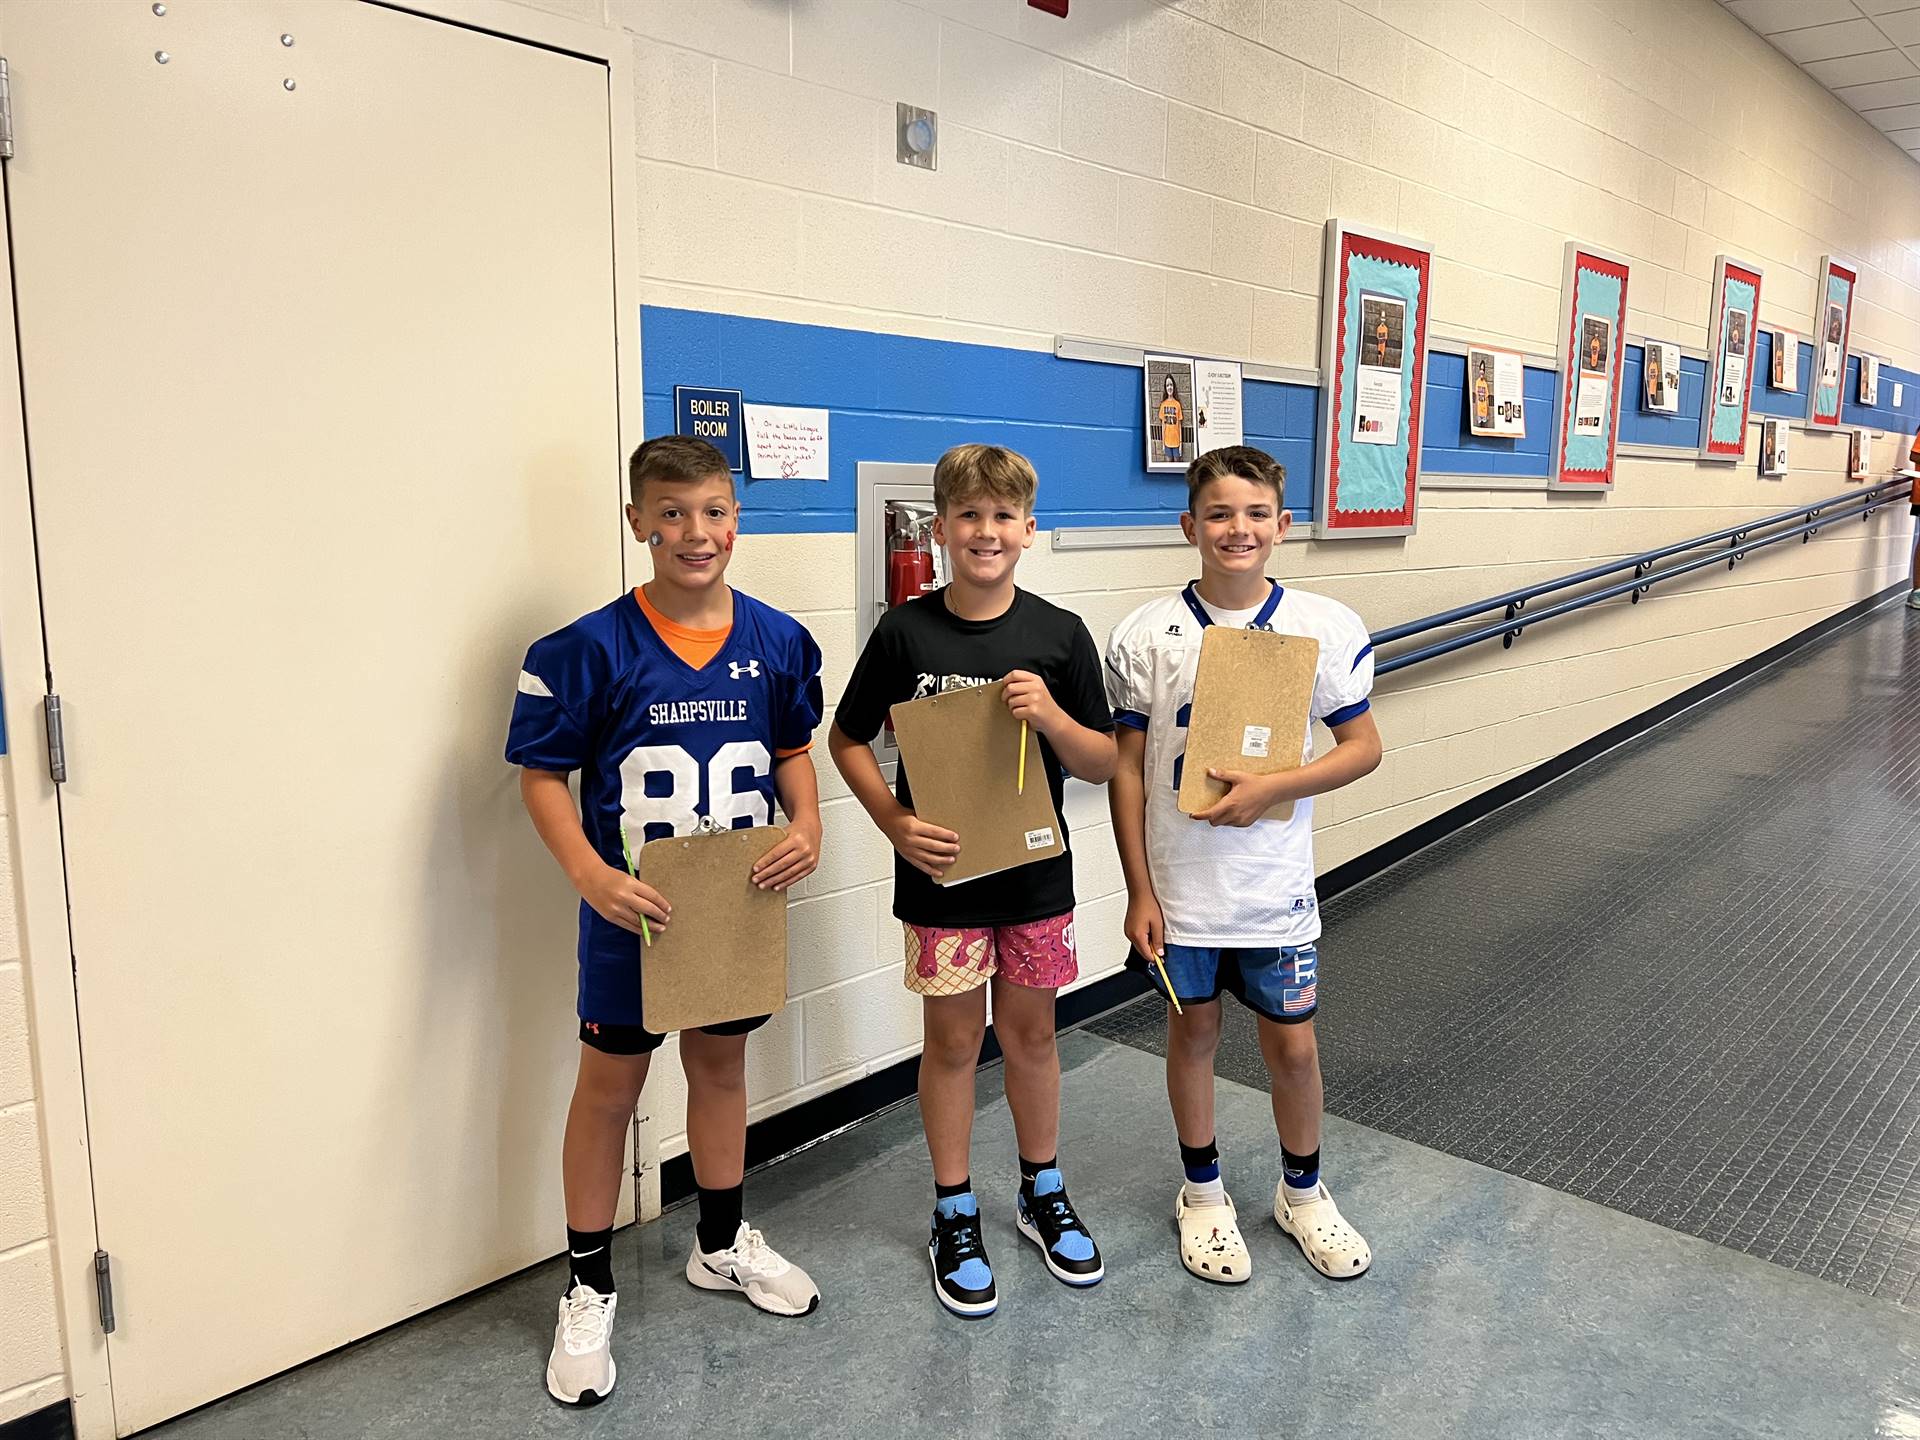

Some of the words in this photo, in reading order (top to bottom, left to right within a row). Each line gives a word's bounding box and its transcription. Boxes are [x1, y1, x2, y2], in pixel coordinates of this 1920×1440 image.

[690, 399, 730, 417] BOILER
[694, 420, 728, 437] ROOM
[649, 699, 748, 725] SHARPSVILLE
[618, 740, 772, 870] 86
